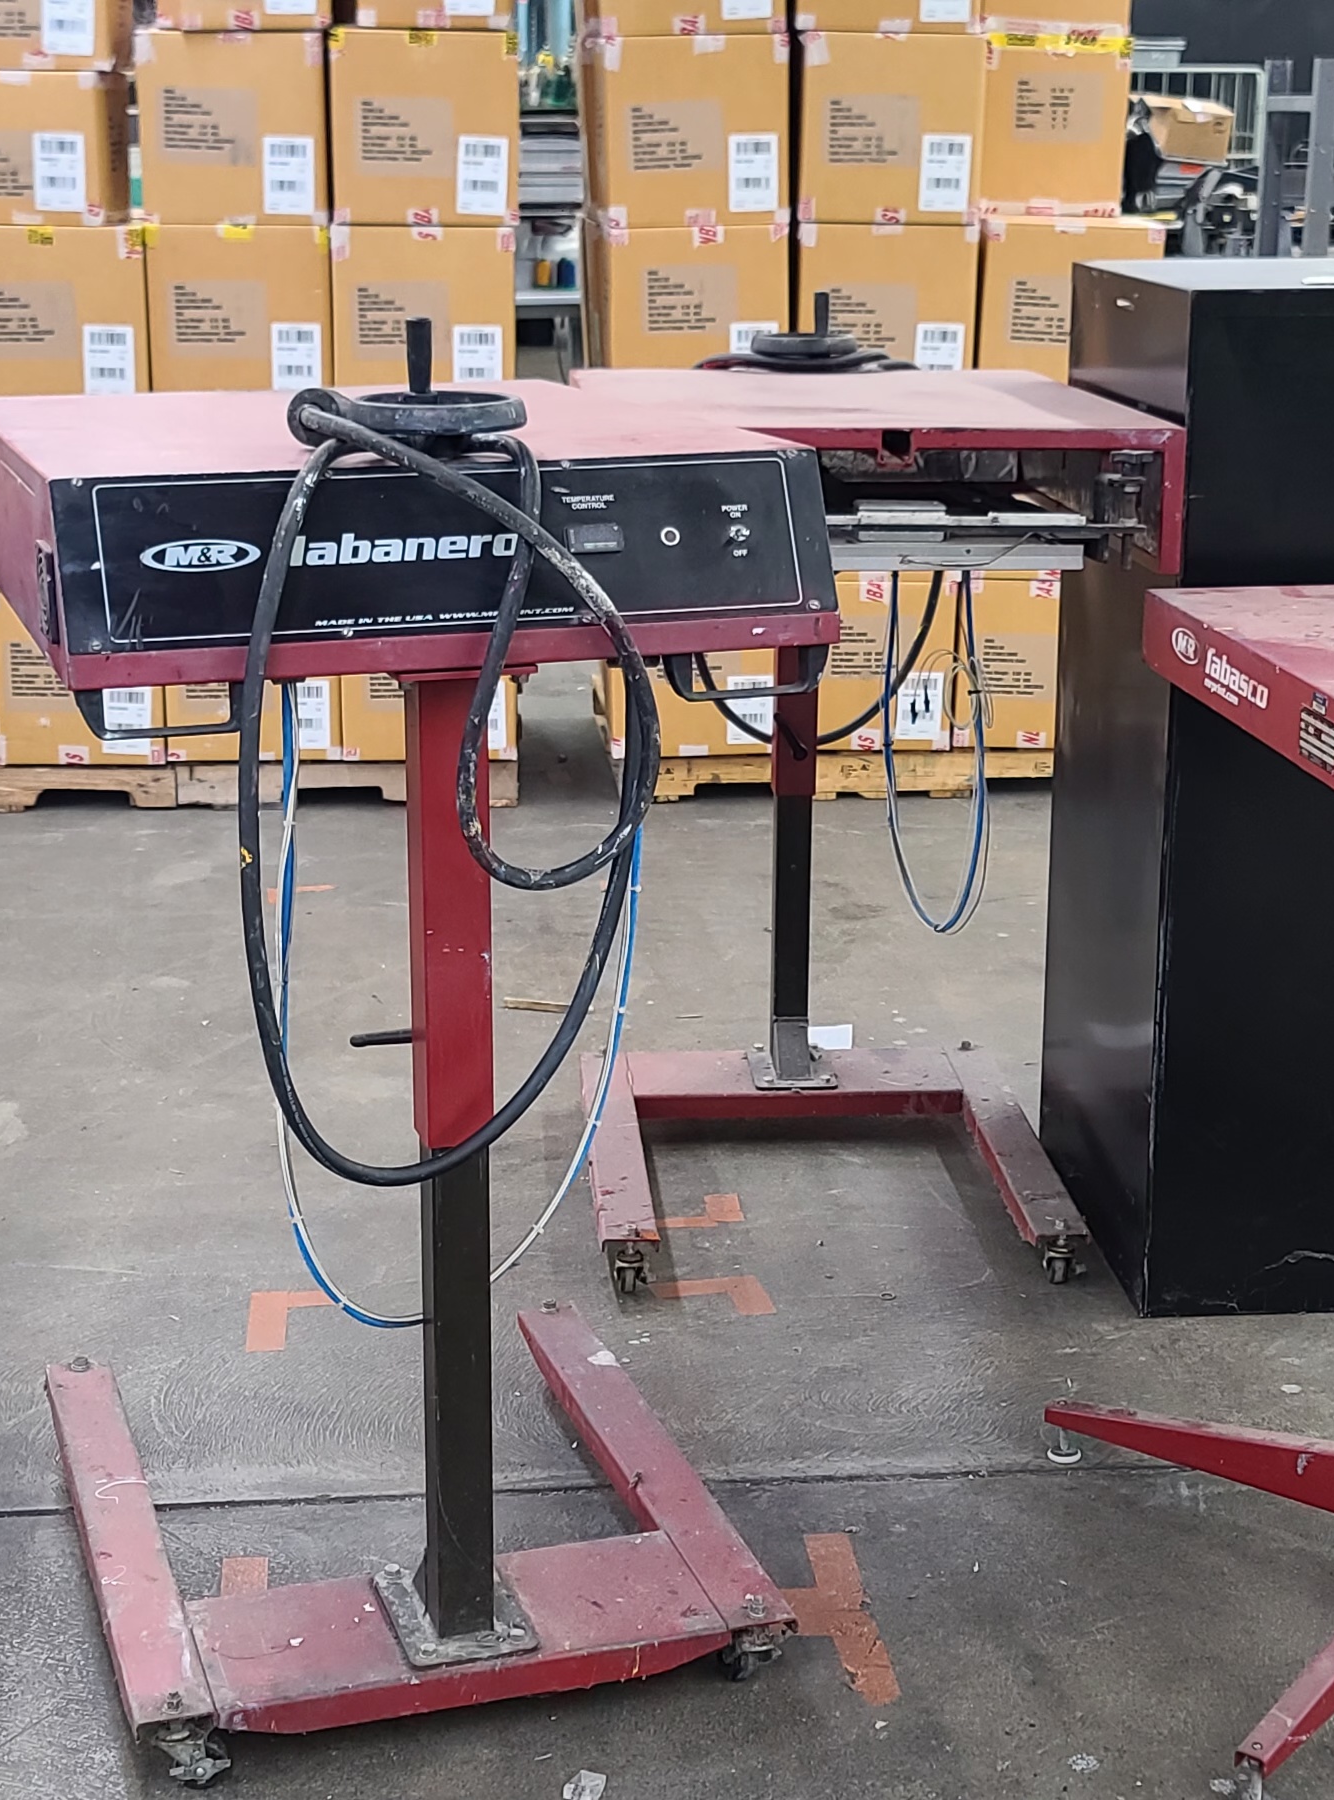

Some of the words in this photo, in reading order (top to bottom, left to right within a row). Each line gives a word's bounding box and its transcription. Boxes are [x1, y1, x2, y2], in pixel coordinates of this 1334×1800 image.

[561, 494, 615, 503] TEMPERATURE
[571, 502, 607, 510] CONTROL
[721, 504, 748, 512] POWER
[165, 544, 239, 567] M&R
[733, 549, 748, 557] OFF
[315, 619, 355, 627] MADE
[358, 617, 373, 625] IN
[377, 616, 402, 624] THE
[406, 614, 433, 622] USA
[438, 606, 574, 620] WWW.MINT.COM
